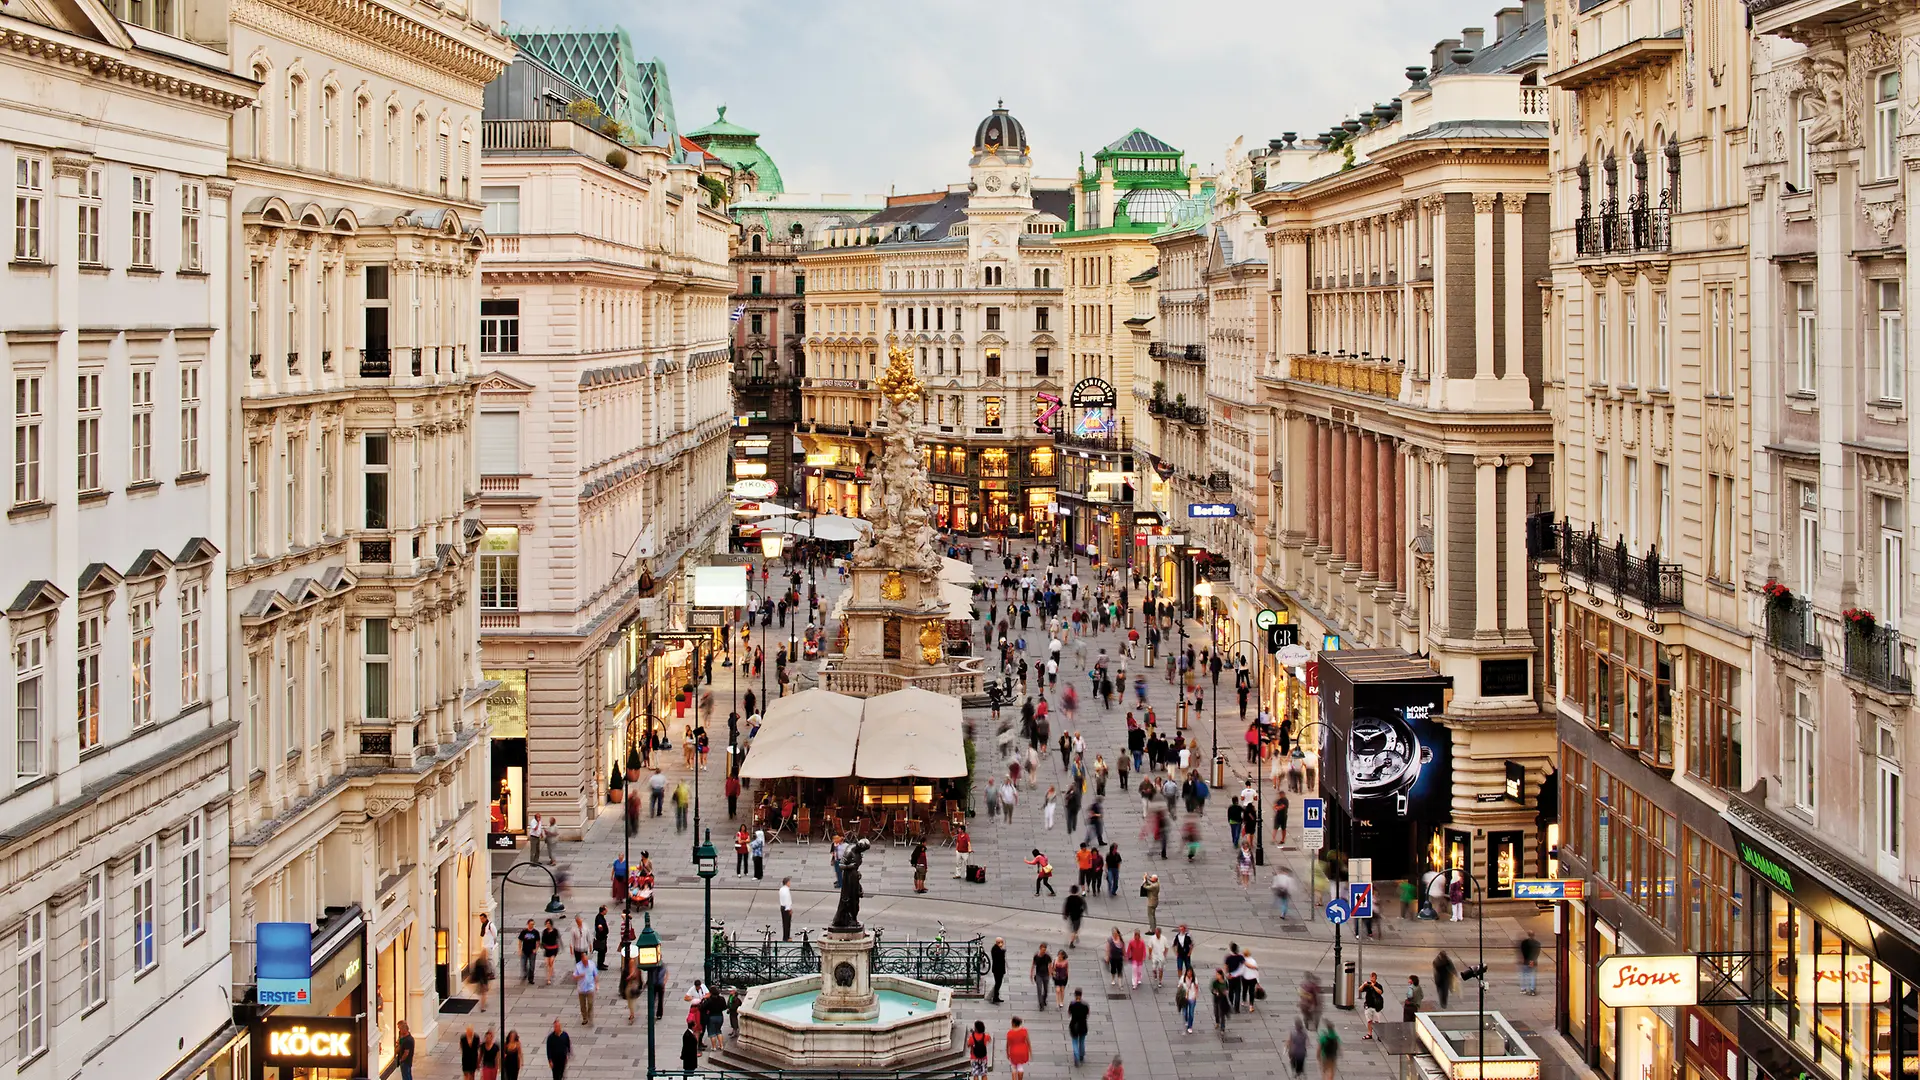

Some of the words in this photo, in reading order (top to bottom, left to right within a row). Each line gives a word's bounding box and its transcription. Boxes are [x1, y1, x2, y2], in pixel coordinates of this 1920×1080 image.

[1193, 505, 1231, 516] Berlitz
[1406, 705, 1429, 713] MONT
[1740, 842, 1795, 893] SALAMANDER
[1612, 964, 1681, 988] Sioux
[260, 991, 296, 1003] ERSTE
[269, 1026, 352, 1056] KÖCK
